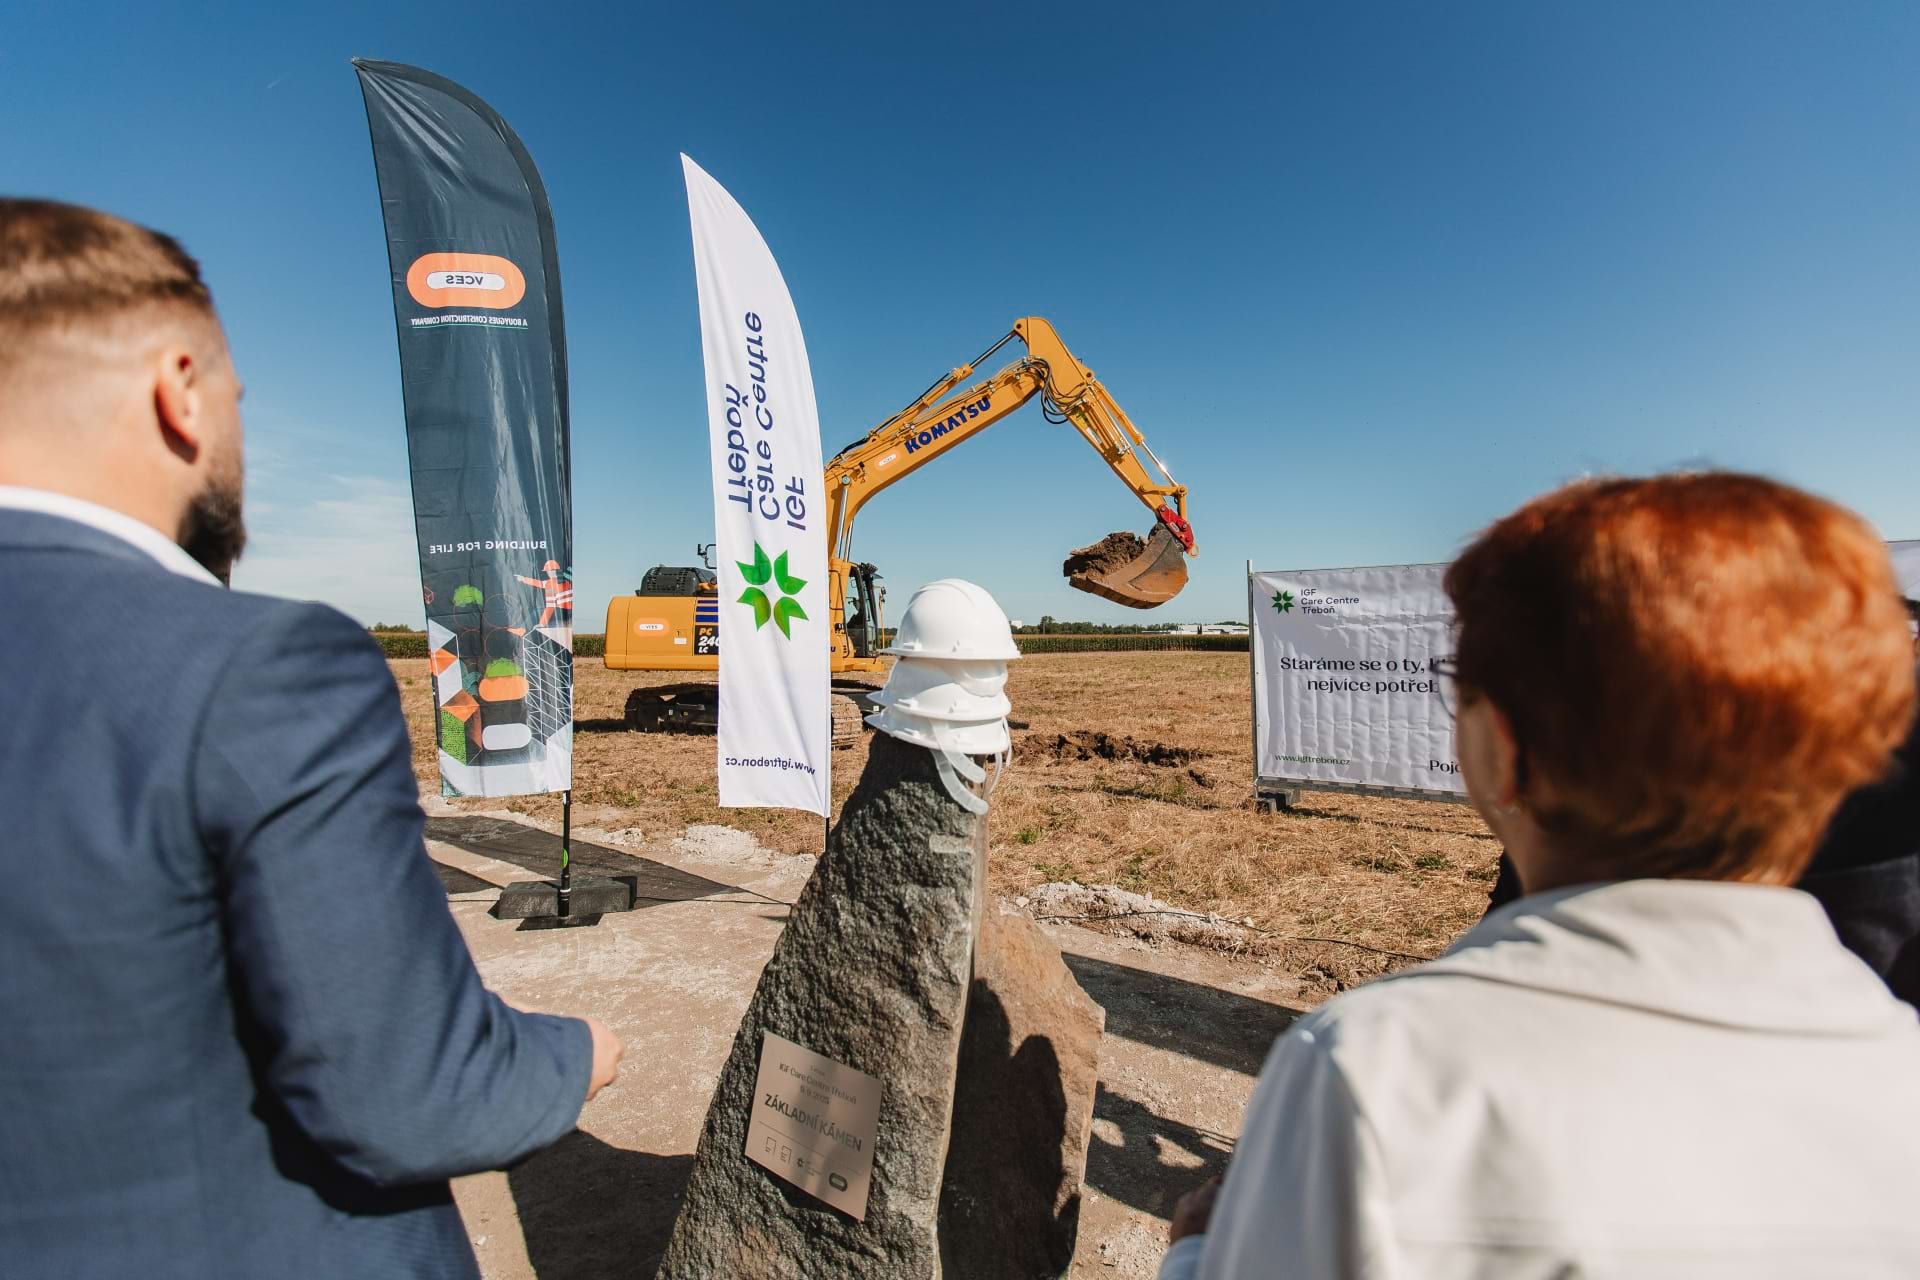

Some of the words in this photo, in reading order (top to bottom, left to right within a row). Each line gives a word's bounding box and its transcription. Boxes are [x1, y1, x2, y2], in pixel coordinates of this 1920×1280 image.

[904, 395, 991, 455] KOMATSU
[1300, 588, 1317, 596] IGF
[1300, 597, 1323, 605] Care
[1325, 596, 1360, 605] Centre
[1301, 605, 1335, 614] Třeboň
[698, 627, 713, 636] PC
[698, 646, 709, 654] LC
[1280, 656, 1355, 671] Staráme
[1359, 659, 1382, 671] se
[1386, 659, 1398, 671] o
[1402, 657, 1425, 674] ty,
[1307, 677, 1371, 694] nejvíce
[1375, 678, 1441, 694] potřeb
[1274, 754, 1351, 766] www.igftrebon.cz
[764, 1093, 820, 1130] ZÁKLADNÍ
[819, 1122, 862, 1152] KÁMEN
